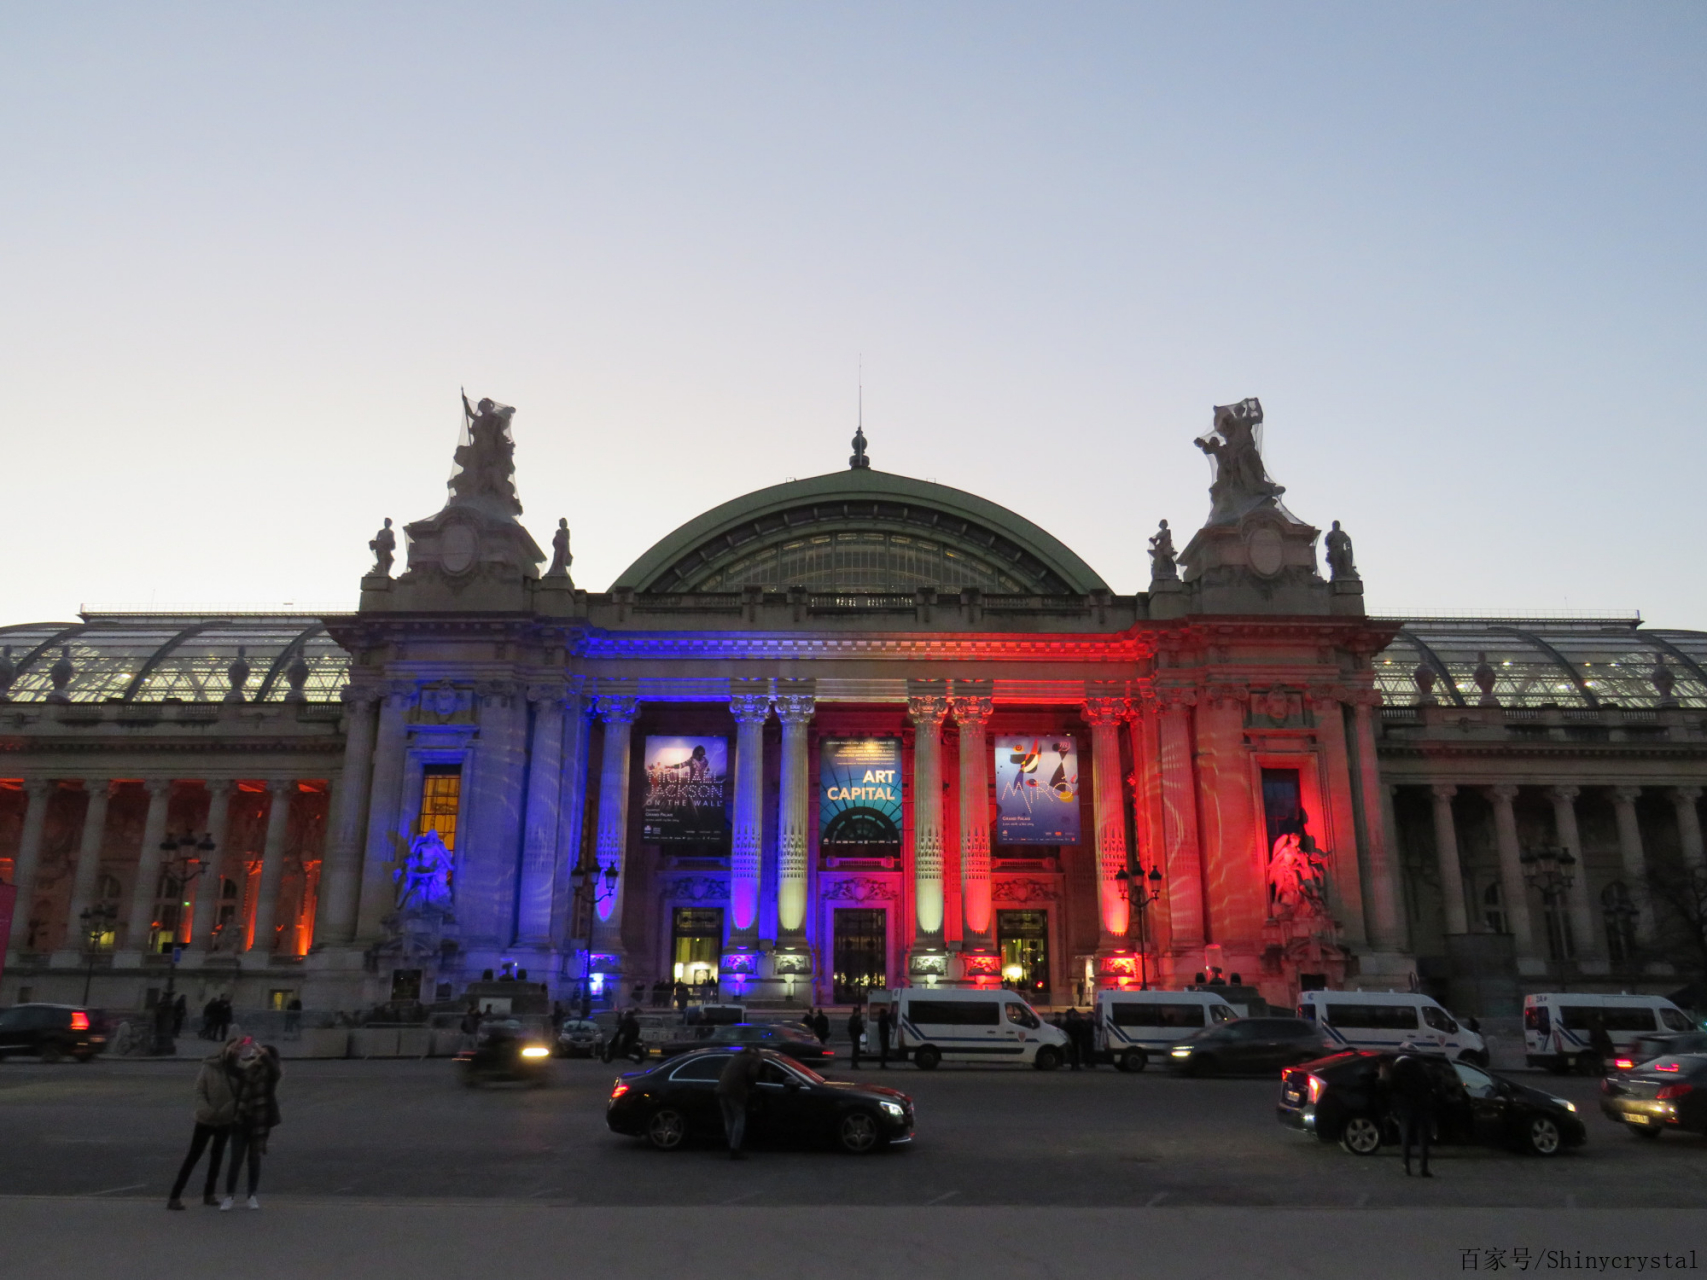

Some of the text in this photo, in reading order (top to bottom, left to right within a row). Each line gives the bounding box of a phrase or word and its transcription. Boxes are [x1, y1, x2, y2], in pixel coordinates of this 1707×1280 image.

[647, 769, 723, 783] MICHAEL
[863, 770, 895, 783] ART
[646, 784, 723, 798] JACKSON
[827, 787, 895, 801] CAPITAL
[667, 799, 687, 807] THE
[693, 799, 723, 807] WALL
